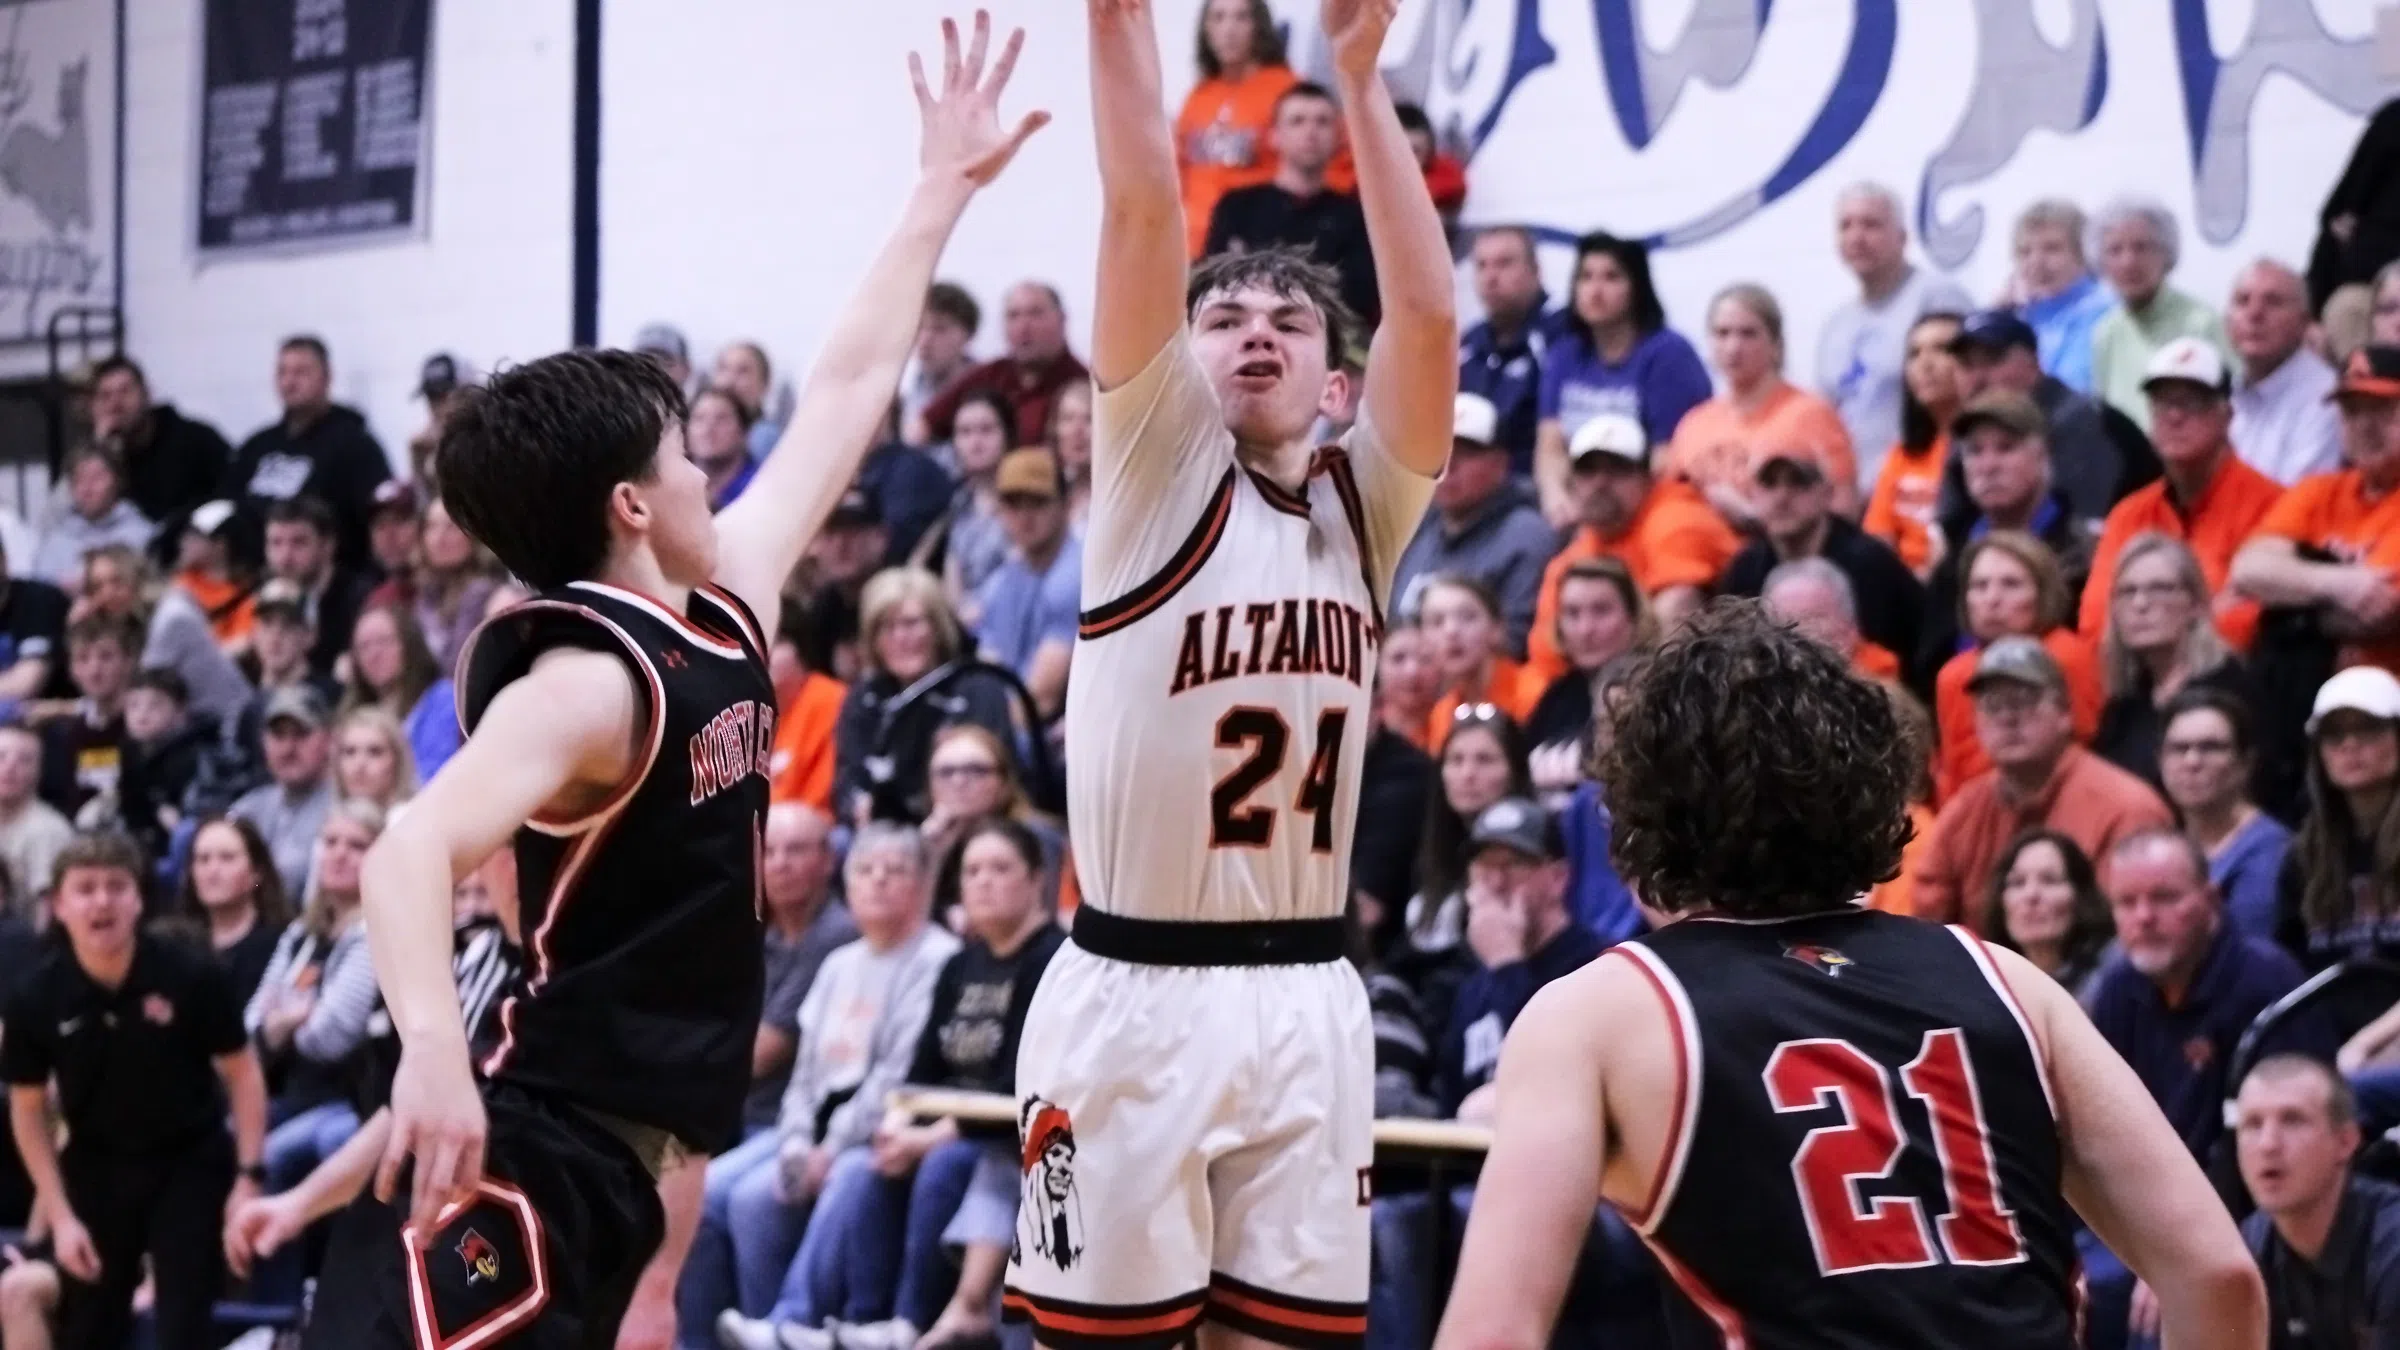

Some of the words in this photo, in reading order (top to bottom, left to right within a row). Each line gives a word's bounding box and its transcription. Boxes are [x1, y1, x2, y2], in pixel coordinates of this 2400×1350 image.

[1168, 597, 1374, 697] ALTAMON
[1208, 704, 1348, 854] 24
[1761, 1027, 2030, 1278] 21
